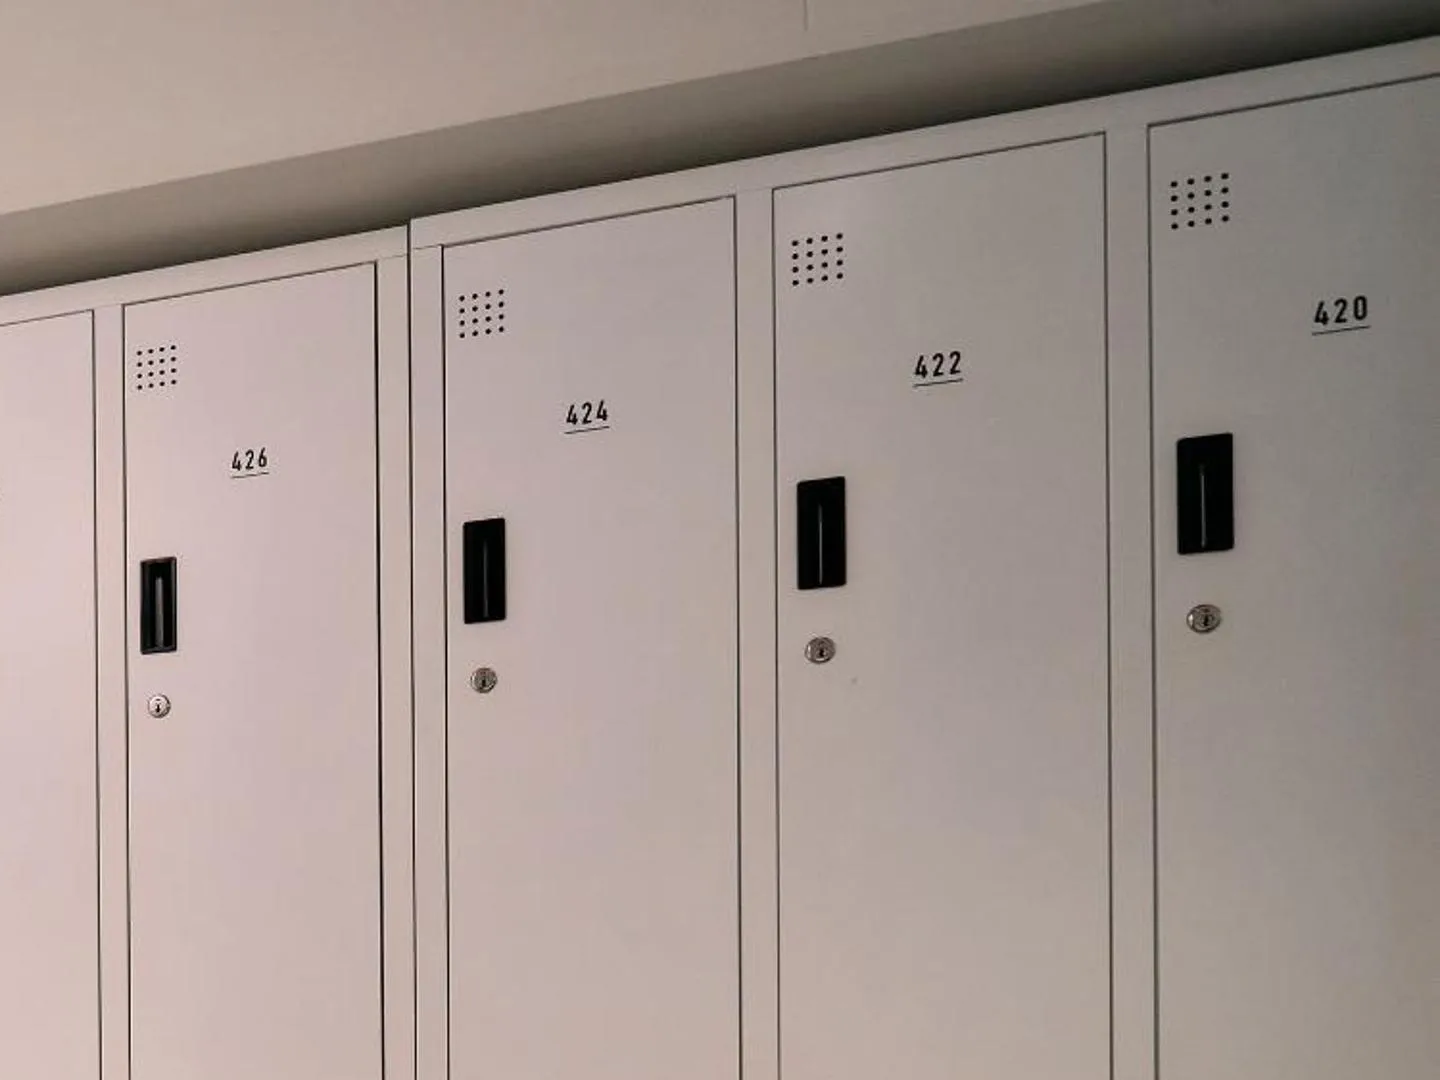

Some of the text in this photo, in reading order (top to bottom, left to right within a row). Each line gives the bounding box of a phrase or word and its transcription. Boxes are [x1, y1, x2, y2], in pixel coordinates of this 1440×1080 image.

[1314, 295, 1368, 326] 420
[914, 350, 962, 379] 422
[566, 400, 608, 425] 424
[231, 447, 267, 471] 426
